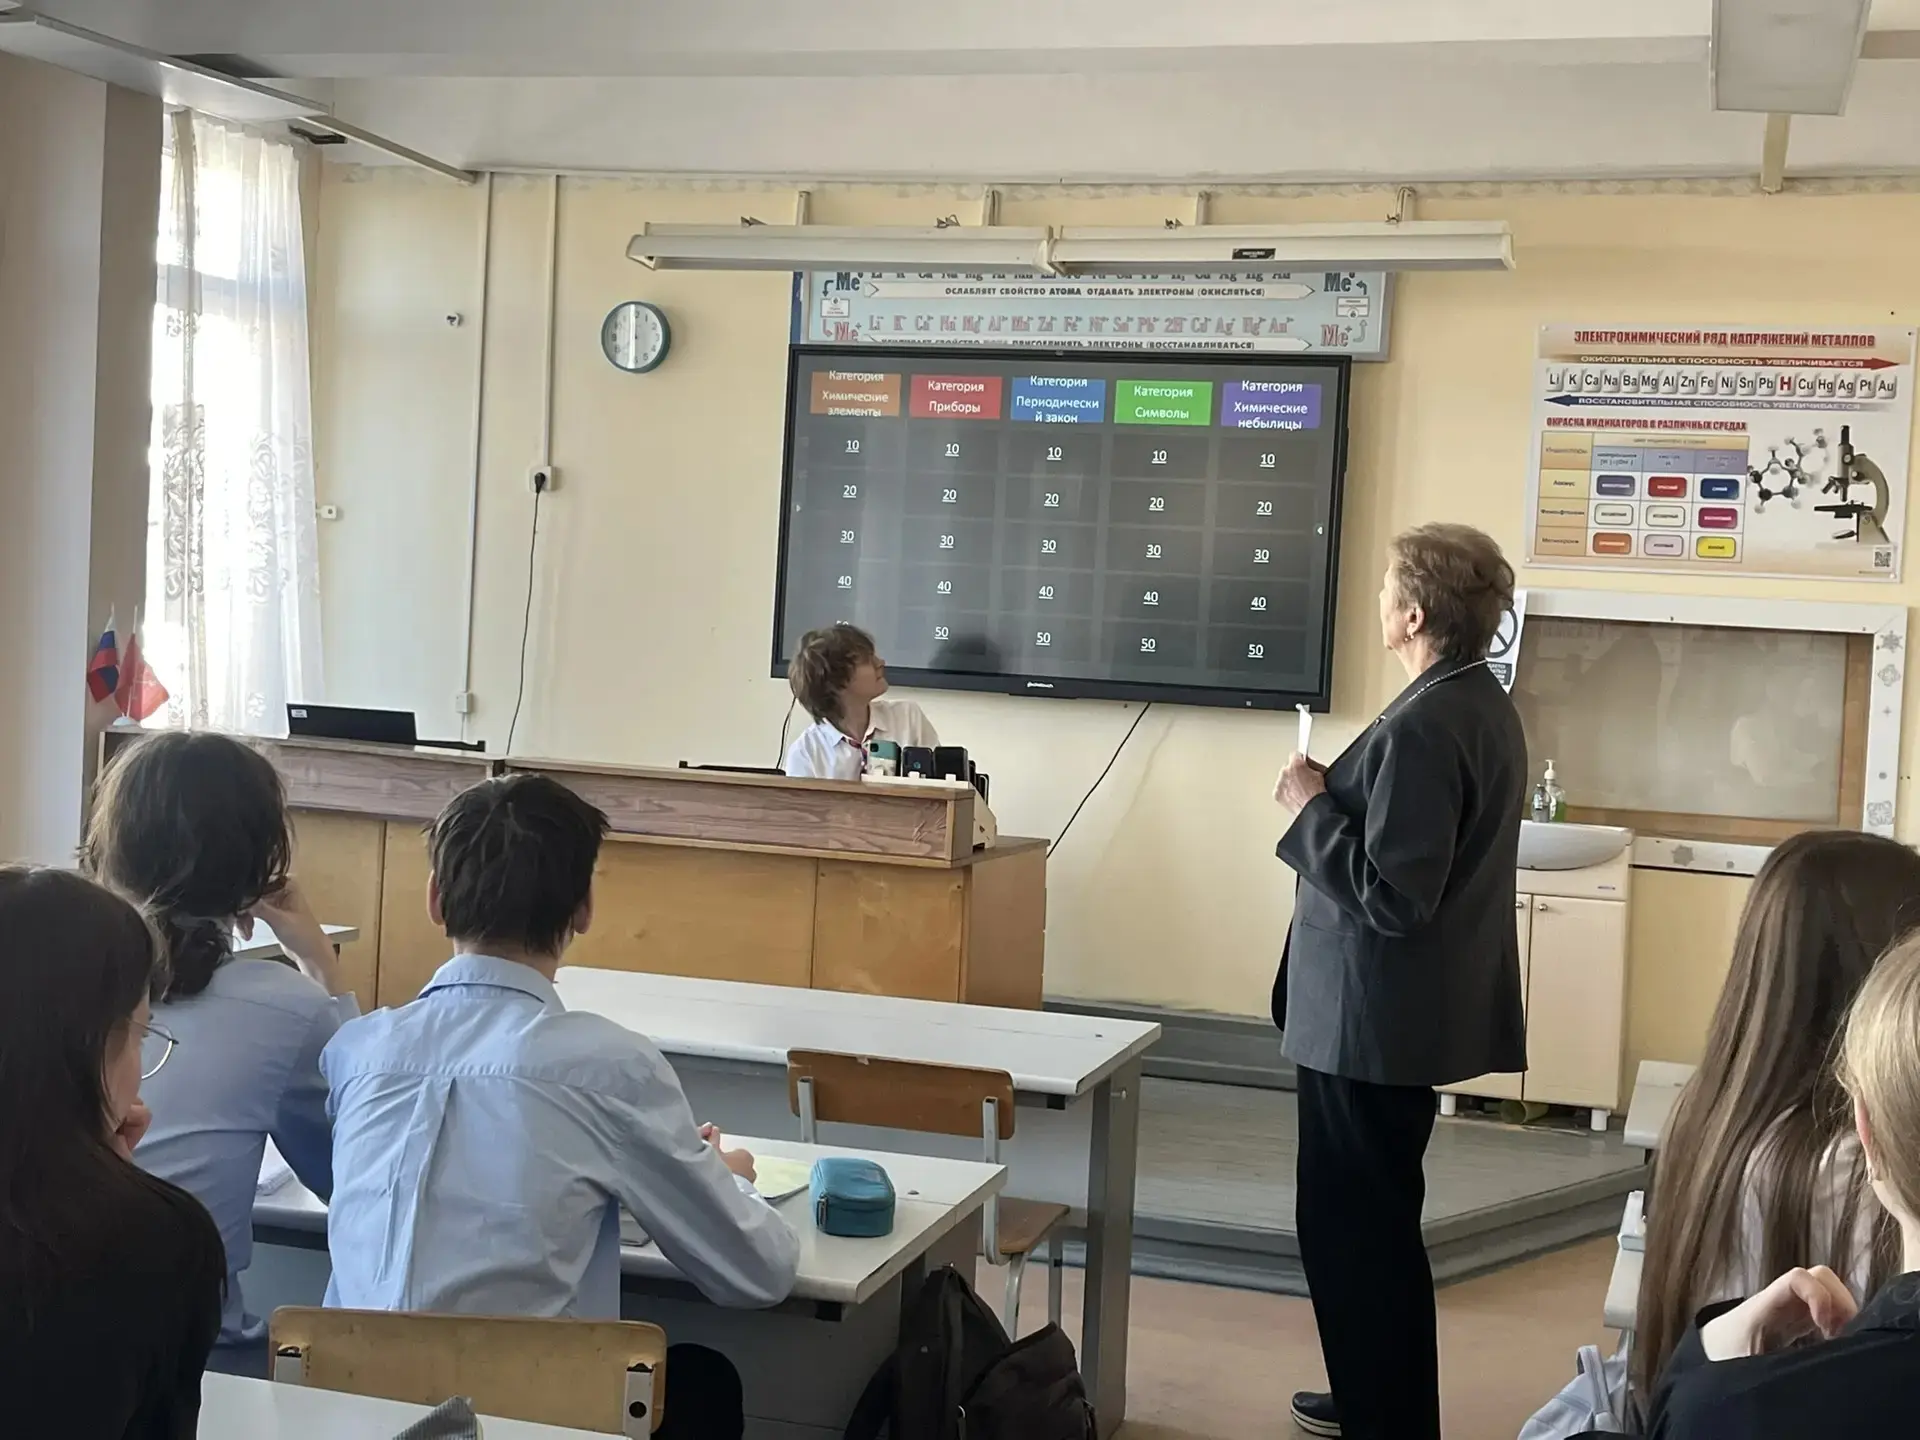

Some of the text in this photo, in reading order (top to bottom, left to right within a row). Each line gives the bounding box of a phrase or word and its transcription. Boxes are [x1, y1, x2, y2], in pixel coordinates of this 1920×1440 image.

[945, 286, 1265, 297] ОСЛАБЛЯЕТ СВОЙСТВО АТОМА ОТДАВАТЬ ЭЛЕКТРОНЫ (ОКИСЛЯТЬСЯ)
[1574, 330, 1876, 347] ЭЛЕКТРОХИМИЧЕСКИЙ РЯД НАПРЯЖЕНИЙ МЕТАЛЛОВ
[1580, 355, 1864, 367] ОКИСЛИТЕЛЬНАЯ СПОСОБНОСТЬ УВЕЛИЧИВАЕТСЯ
[829, 370, 884, 383] Категория
[1030, 375, 1088, 388] Категория
[1549, 373, 1894, 393] Li K Ca Na Ba Mg Al Zn Fe Ni Sn Pb H Cu Hg Ag Pt Au
[928, 380, 985, 393] Категория
[1134, 385, 1193, 398] Категория
[1241, 380, 1303, 394] Категория
[822, 390, 889, 403] Химические
[1016, 396, 1099, 409] Периодически
[929, 401, 981, 414] Приборы
[1233, 401, 1308, 414] Химические
[1578, 397, 1860, 410] ВОССТАНОВИТЕЛЬНАЯ СПОСОБНОСТЬ УВЕЛИЧИВАЕТСЯ
[827, 407, 882, 417] элементы
[1035, 411, 1078, 423] й закон
[1135, 407, 1189, 419] Символы
[1237, 417, 1302, 431] небылицы
[1546, 417, 1585, 426] ОКРАСКА
[1586, 418, 1648, 428] ИНДИКАТОРОВ
[1657, 420, 1711, 429] РАЗЛИЧНЫХ
[1713, 421, 1747, 431] СРЕДАХ
[846, 440, 859, 452] 10
[945, 444, 959, 456] 10
[1047, 447, 1061, 460] 10
[1152, 451, 1166, 463] 10
[1260, 454, 1275, 467] 10
[843, 485, 856, 497] 20
[943, 490, 956, 502] 20
[1044, 494, 1058, 506] 20
[1149, 498, 1164, 510] 20
[1257, 502, 1271, 515] 20
[841, 531, 854, 543] 30
[940, 535, 953, 548] 30
[1042, 540, 1056, 553] 30
[1146, 545, 1161, 558] 30
[1254, 549, 1269, 562] 30
[838, 576, 851, 588] 40
[938, 581, 951, 593] 40
[1039, 586, 1053, 599] 40
[1144, 592, 1158, 605] 40
[1251, 597, 1266, 610] 40
[935, 627, 948, 639] 50
[1036, 632, 1050, 645] 50
[1141, 639, 1155, 651] 50
[1248, 644, 1263, 658] 50
